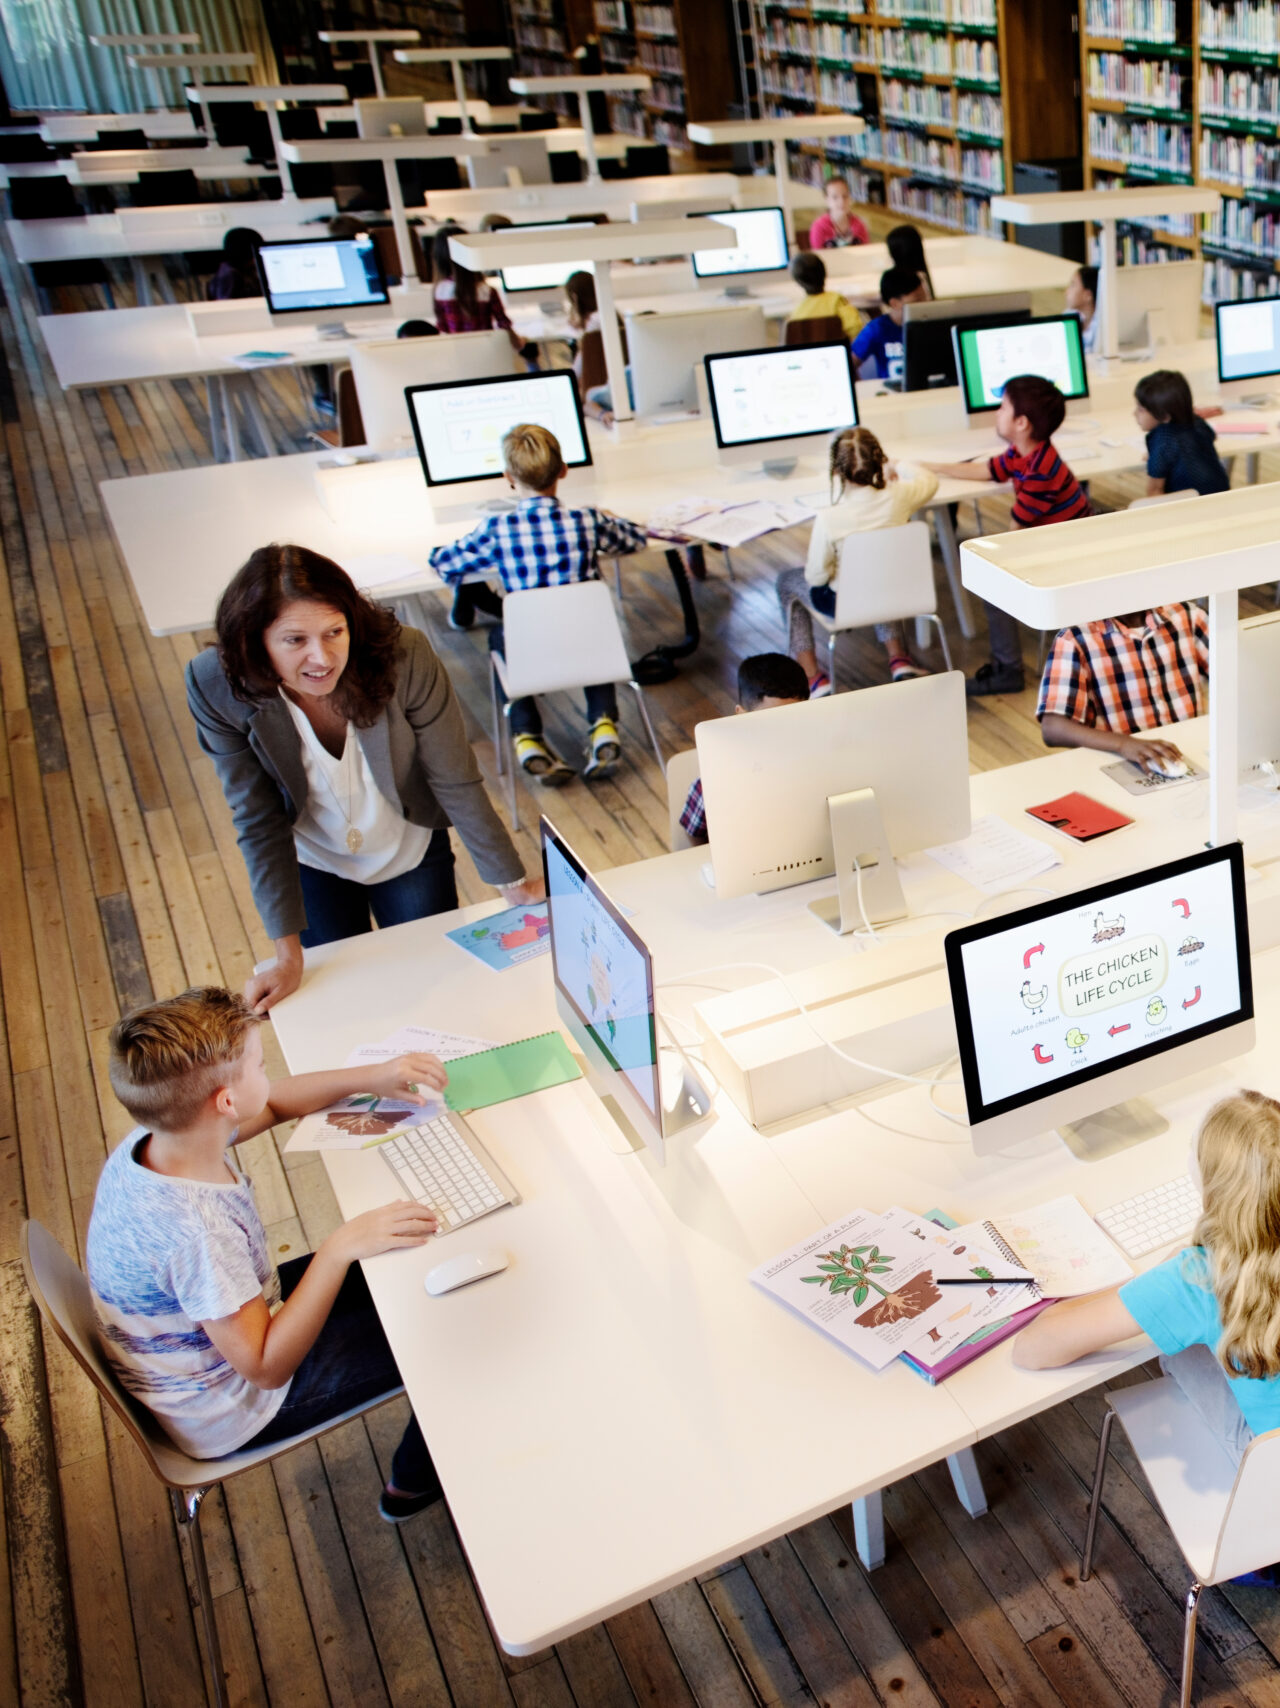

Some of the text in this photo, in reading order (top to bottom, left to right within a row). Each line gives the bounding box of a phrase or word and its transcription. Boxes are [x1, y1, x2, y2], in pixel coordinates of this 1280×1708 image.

[1064, 944, 1159, 988] THE CHICKEN
[1076, 968, 1153, 1006] LIFE CYCLE
[1144, 1025, 1173, 1039] Hatching
[1070, 1056, 1088, 1067] Chick
[762, 1256, 792, 1278] LESSON
[803, 1239, 821, 1252] PART
[823, 1232, 832, 1241] OF
[841, 1215, 861, 1230] PLANT
